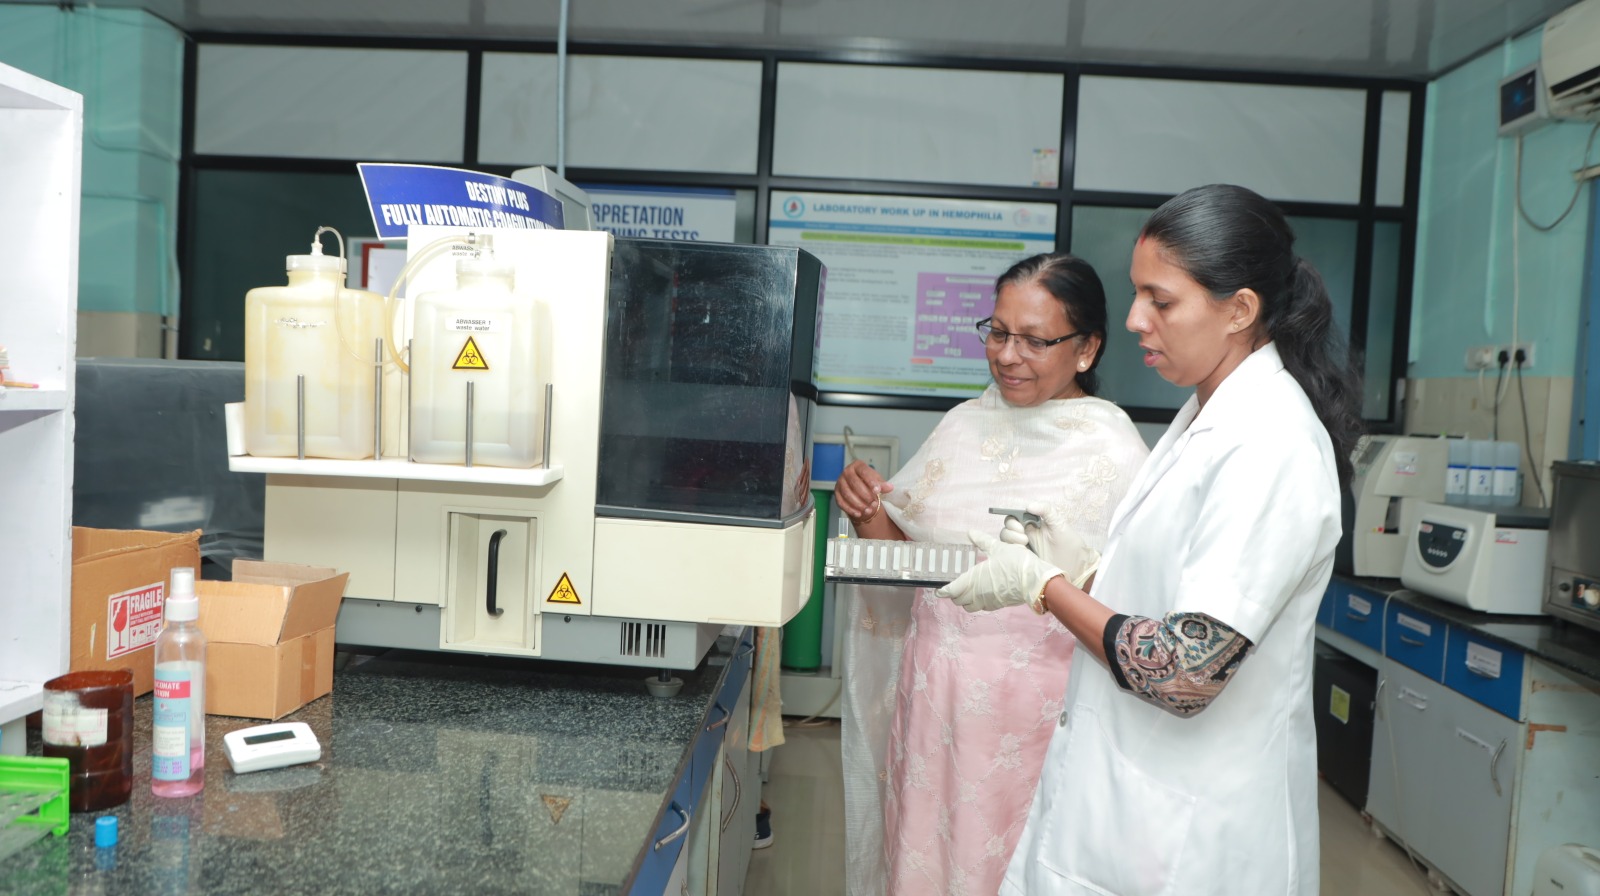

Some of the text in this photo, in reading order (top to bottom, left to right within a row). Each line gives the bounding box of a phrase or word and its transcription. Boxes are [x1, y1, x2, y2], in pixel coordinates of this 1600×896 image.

[465, 181, 530, 212] DESTINY PLUS
[381, 204, 422, 226] FULLY
[424, 204, 493, 228] AUTOMATIC
[813, 203, 877, 215] LABORATORY
[880, 206, 909, 217] WORK
[912, 208, 927, 217] UP
[929, 209, 939, 218] IN
[942, 210, 1003, 221] HEMOPHILIA
[1479, 474, 1487, 485] 2
[130, 588, 162, 614] FRAGILE
